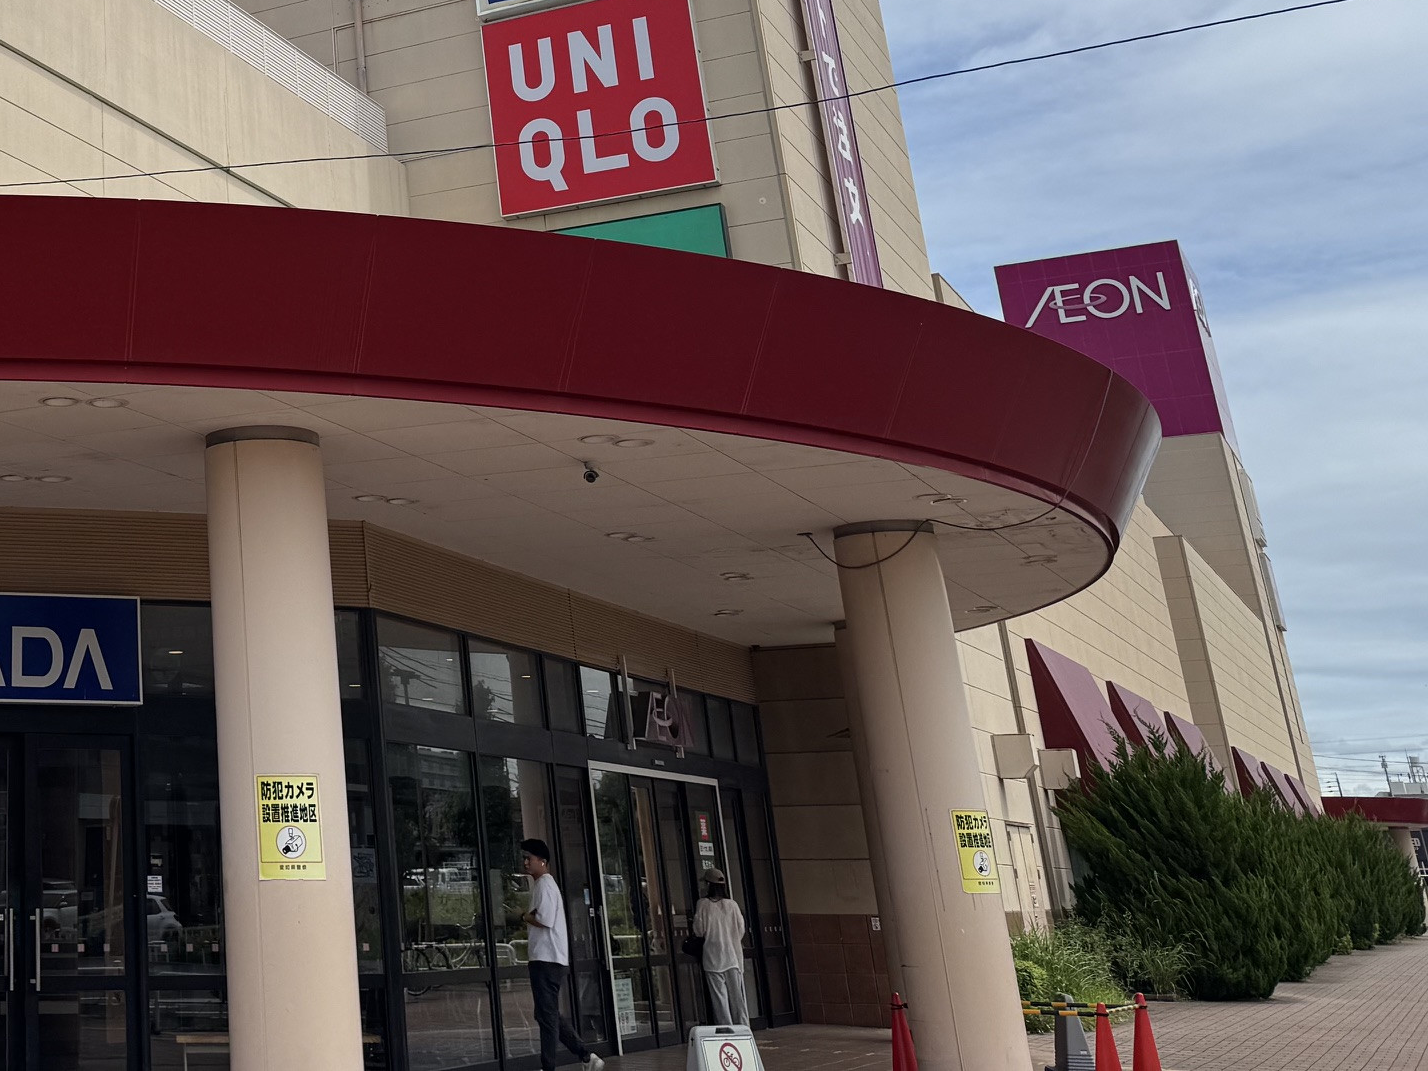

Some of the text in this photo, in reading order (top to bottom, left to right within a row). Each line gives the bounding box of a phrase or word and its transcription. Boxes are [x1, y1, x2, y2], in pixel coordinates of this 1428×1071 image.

[508, 16, 654, 102] UNI
[519, 97, 680, 191] QLO
[260, 781, 315, 801] 防犯カメラ
[261, 803, 317, 823] 設置推進地区
[955, 814, 988, 830] 防犯カメラ
